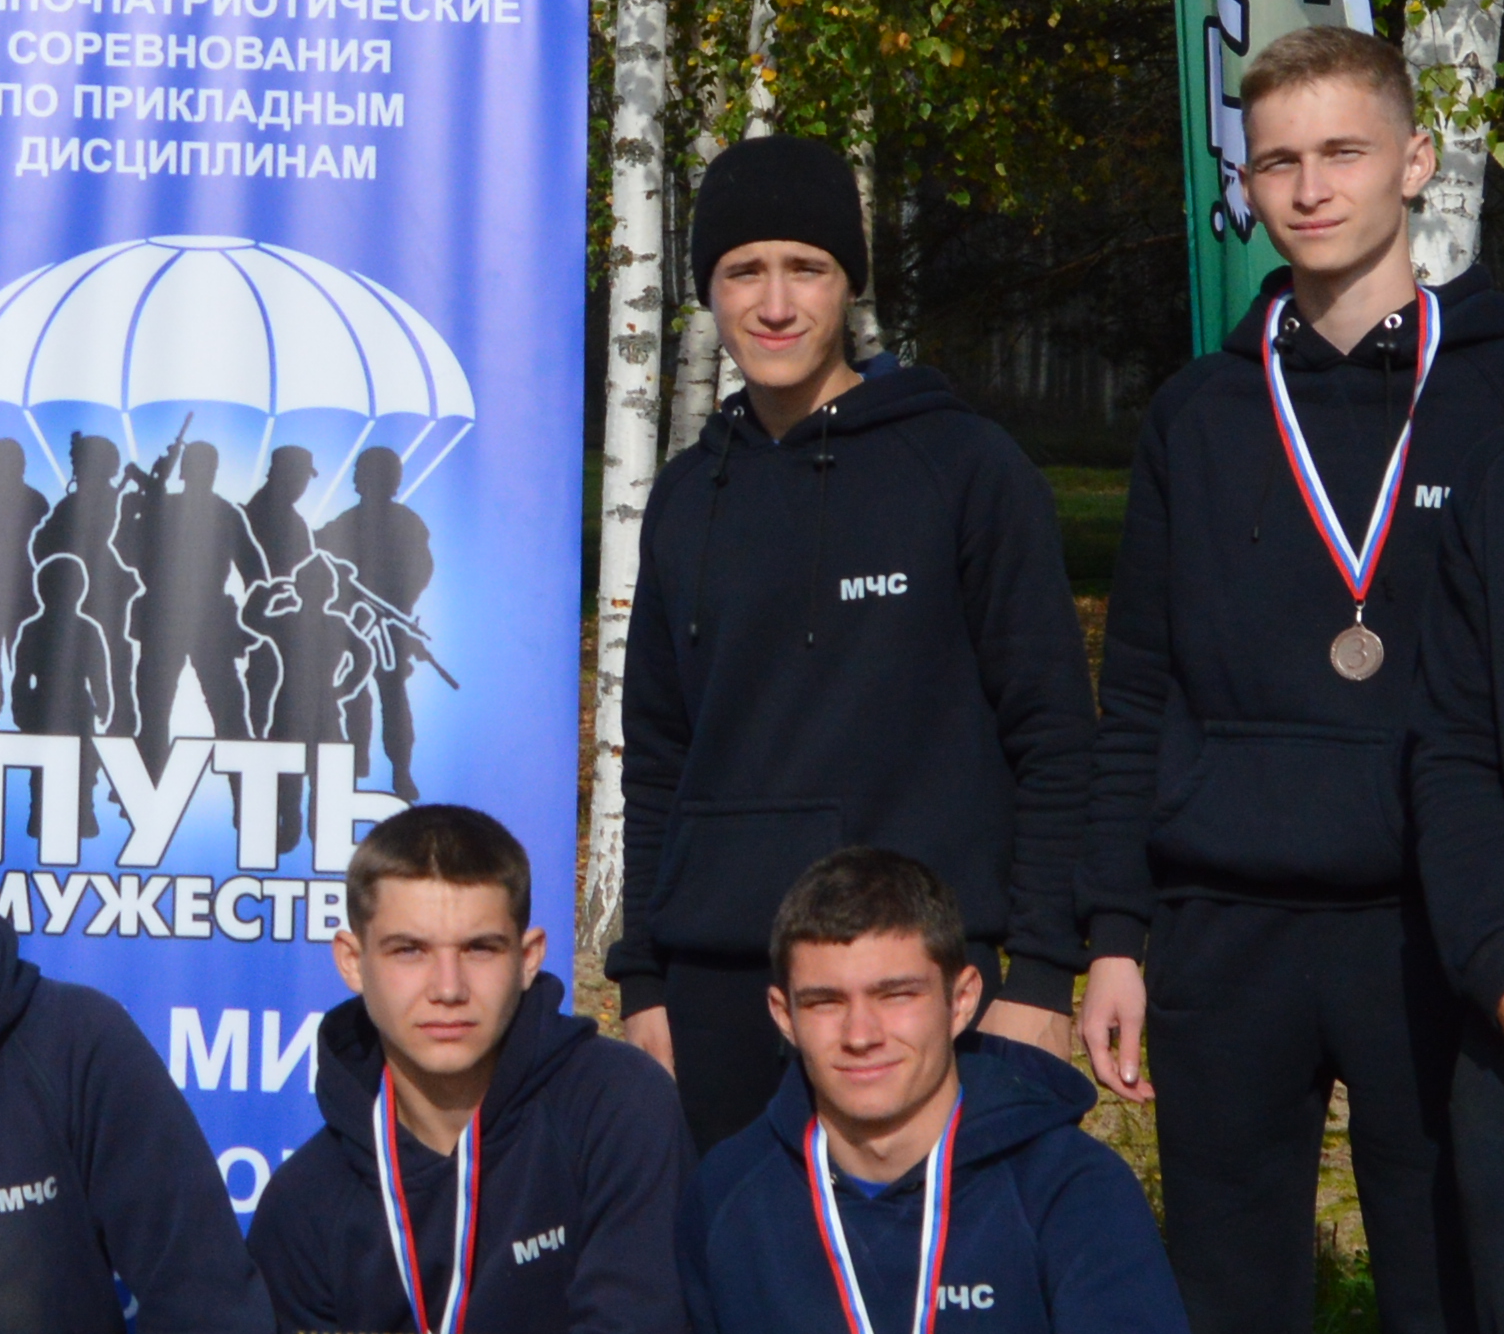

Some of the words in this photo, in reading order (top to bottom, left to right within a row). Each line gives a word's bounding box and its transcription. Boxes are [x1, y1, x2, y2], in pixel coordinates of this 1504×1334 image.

[6, 31, 393, 74] СОРЕВНОВАНИЯ
[72, 86, 406, 131] ПРИКЛАДНЫМ
[14, 137, 379, 181] ДИСЦИПЛИНАМ
[838, 570, 909, 602] МЧС
